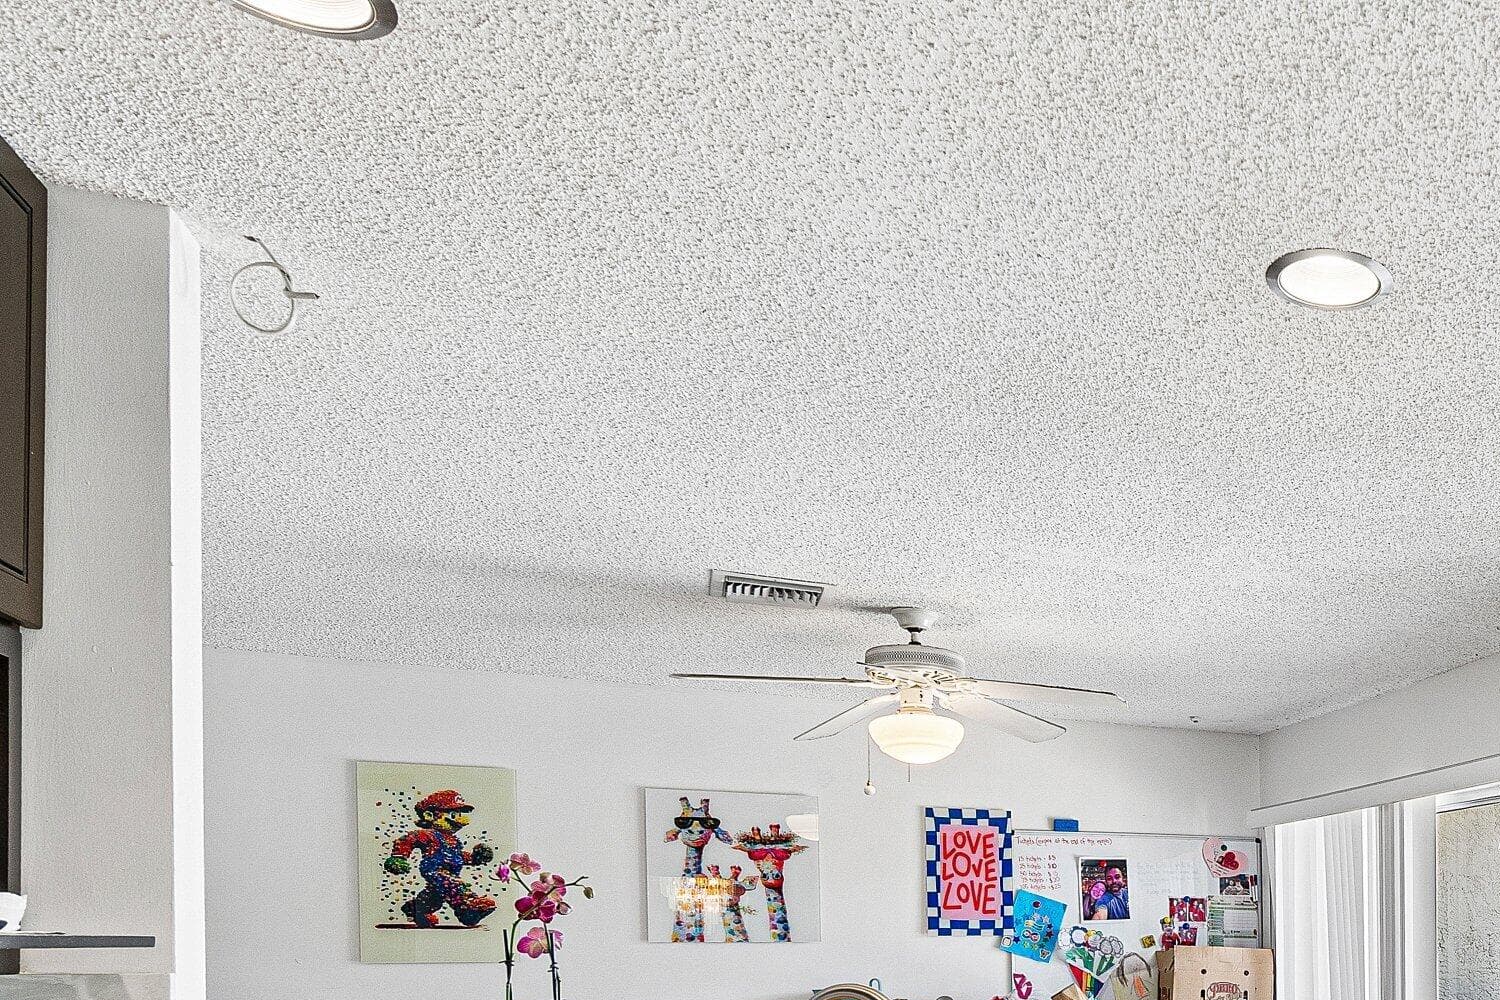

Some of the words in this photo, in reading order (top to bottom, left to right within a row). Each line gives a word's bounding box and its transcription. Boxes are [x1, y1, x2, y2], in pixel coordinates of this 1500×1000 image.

[942, 830, 995, 860] LOVE
[942, 852, 998, 882] LOVE
[942, 880, 997, 915] LOVE
